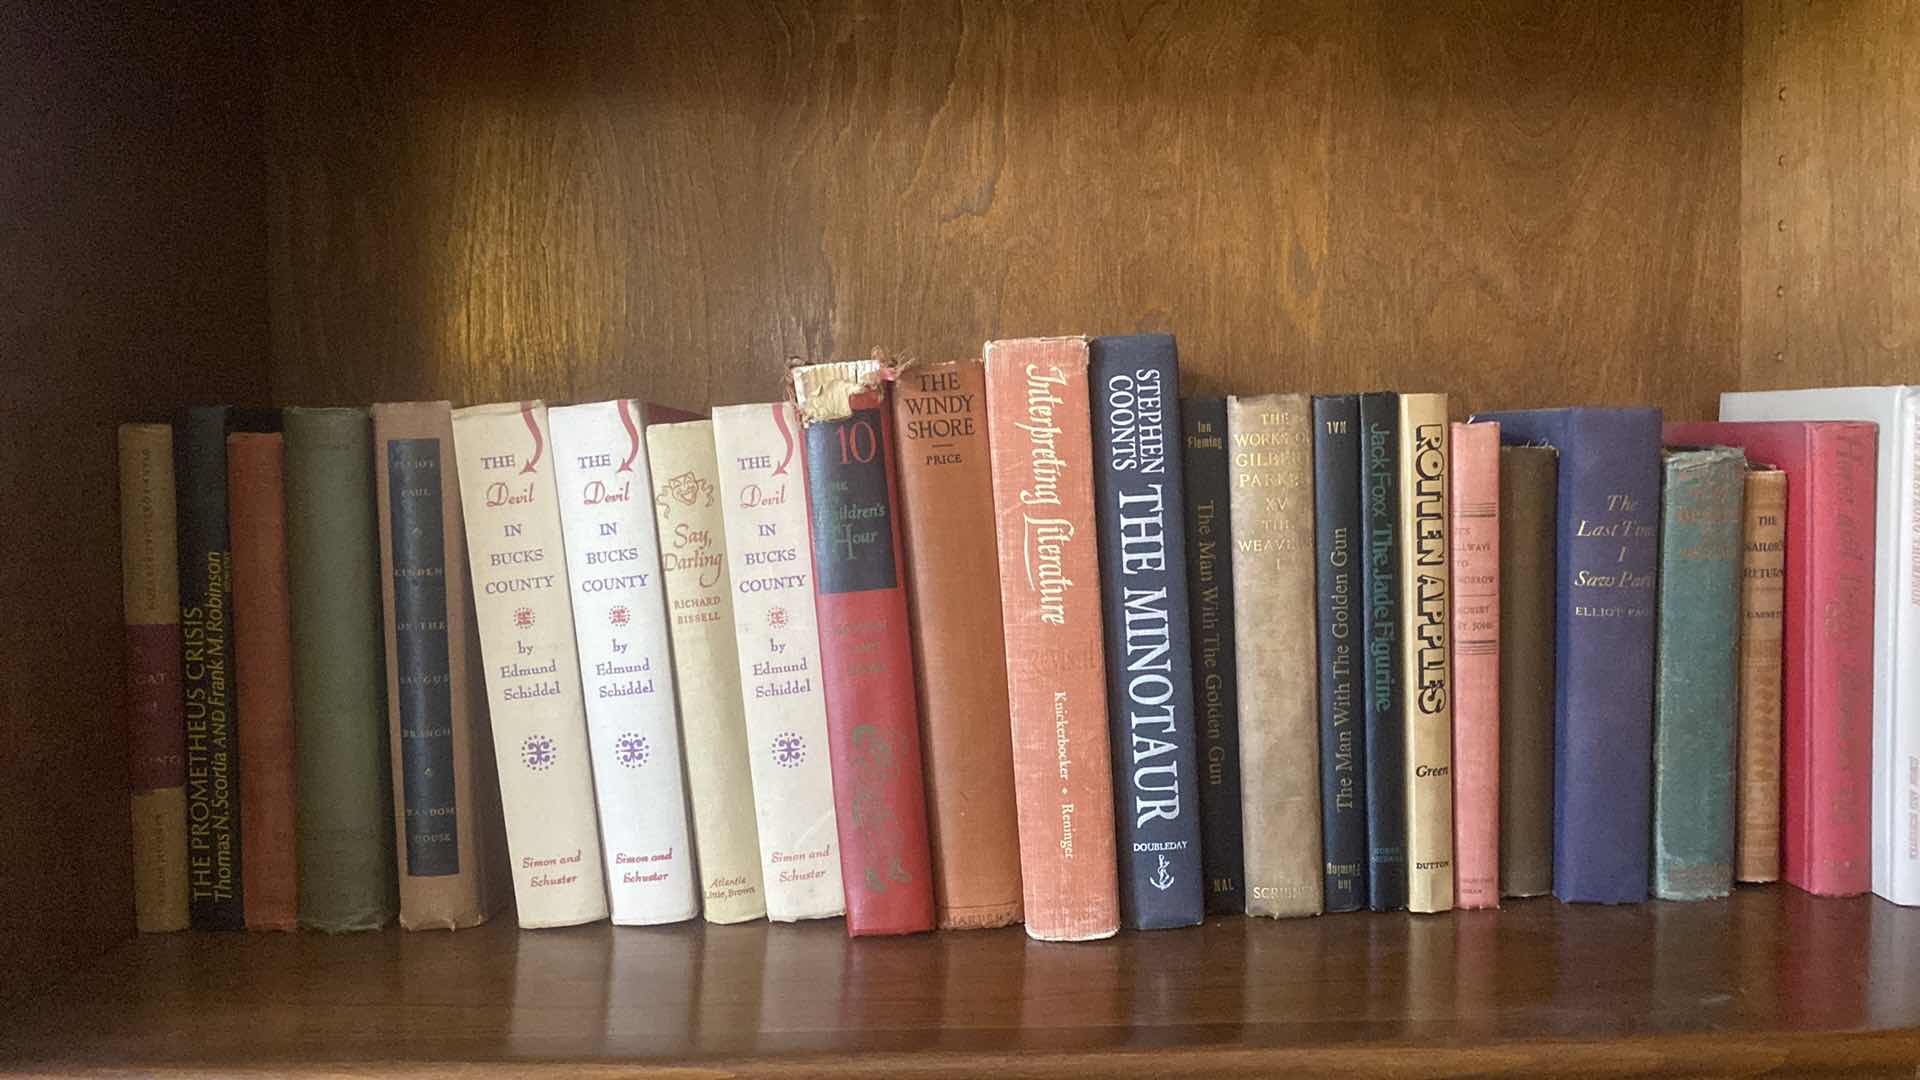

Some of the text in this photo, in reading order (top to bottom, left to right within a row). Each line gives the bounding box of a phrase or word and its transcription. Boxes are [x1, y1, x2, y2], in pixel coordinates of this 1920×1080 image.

[919, 371, 960, 392] THE
[904, 394, 975, 415] WINDY
[907, 418, 975, 439] SHORE
[1109, 375, 1137, 470] COONTS
[1134, 368, 1164, 475] STEPHEN
[1197, 420, 1212, 433] Ian
[1261, 412, 1289, 426] THE
[836, 421, 877, 464] 10
[1015, 362, 1067, 504] Interpreting
[1187, 435, 1223, 449] Fleming
[1234, 431, 1289, 448] WORKS
[1371, 423, 1391, 470] Jack
[479, 454, 515, 470] THE
[577, 454, 611, 469] THE
[738, 456, 771, 471] THE
[926, 454, 962, 464] PRICE
[486, 482, 534, 507] Devil
[583, 481, 630, 505] Devil
[740, 484, 785, 508] Devil
[1607, 493, 1640, 512] The
[1265, 497, 1288, 511] XV
[503, 523, 522, 537] IN
[599, 522, 617, 536] IN
[759, 523, 777, 537] IN
[1575, 518, 1618, 537] Last
[1758, 515, 1777, 526] THE
[673, 523, 713, 549] Say,
[1373, 523, 1393, 563] The
[490, 549, 544, 567] BUCKS
[585, 548, 639, 565] BUCKS
[744, 548, 797, 566] BUCKS
[1617, 546, 1627, 562] I
[661, 548, 723, 588] Darling
[1023, 512, 1075, 625] Literature
[1415, 424, 1446, 715] ROTTEN APPLES
[485, 575, 555, 595] COUNTY
[582, 574, 648, 593] COUNTY
[739, 574, 807, 594] COUNTY
[1573, 569, 1616, 588] Saw
[674, 596, 721, 610] RICHARD
[1372, 571, 1394, 618] Jade
[677, 612, 721, 625] BISSELL
[1575, 605, 1621, 617] ELLIOT
[517, 641, 534, 656] by
[612, 639, 628, 653] by
[770, 638, 786, 654] by
[1198, 499, 1225, 785] The Man With The Golden Gun
[1119, 484, 1181, 829] THE MINOTAUR
[500, 660, 558, 679] Edmund
[596, 658, 650, 676] Edmund
[752, 658, 808, 677] Edmund
[1330, 527, 1352, 813] The Man With The Golden Gun
[1371, 621, 1394, 713] Figurine
[503, 681, 561, 701] Schiddel
[599, 680, 655, 699] Schiddel
[755, 680, 811, 699] Schiddel
[204, 550, 233, 901] Thomas N. Scortia AND Frank M. Robinson
[182, 607, 213, 901] THE PROMETHEUS CRISIS
[1055, 691, 1075, 859] Knickerbocker Reninger
[1415, 764, 1449, 778] Green
[615, 848, 673, 864] Simon and
[771, 844, 831, 864] Simon and
[1133, 840, 1188, 853] DOUBLEDAY
[522, 849, 581, 869] Simon and
[1415, 861, 1449, 870] DUTTON
[530, 874, 577, 887] Schuster
[623, 869, 669, 884] Schuster
[710, 875, 747, 889] Atlantic
[779, 868, 825, 883] Schuster
